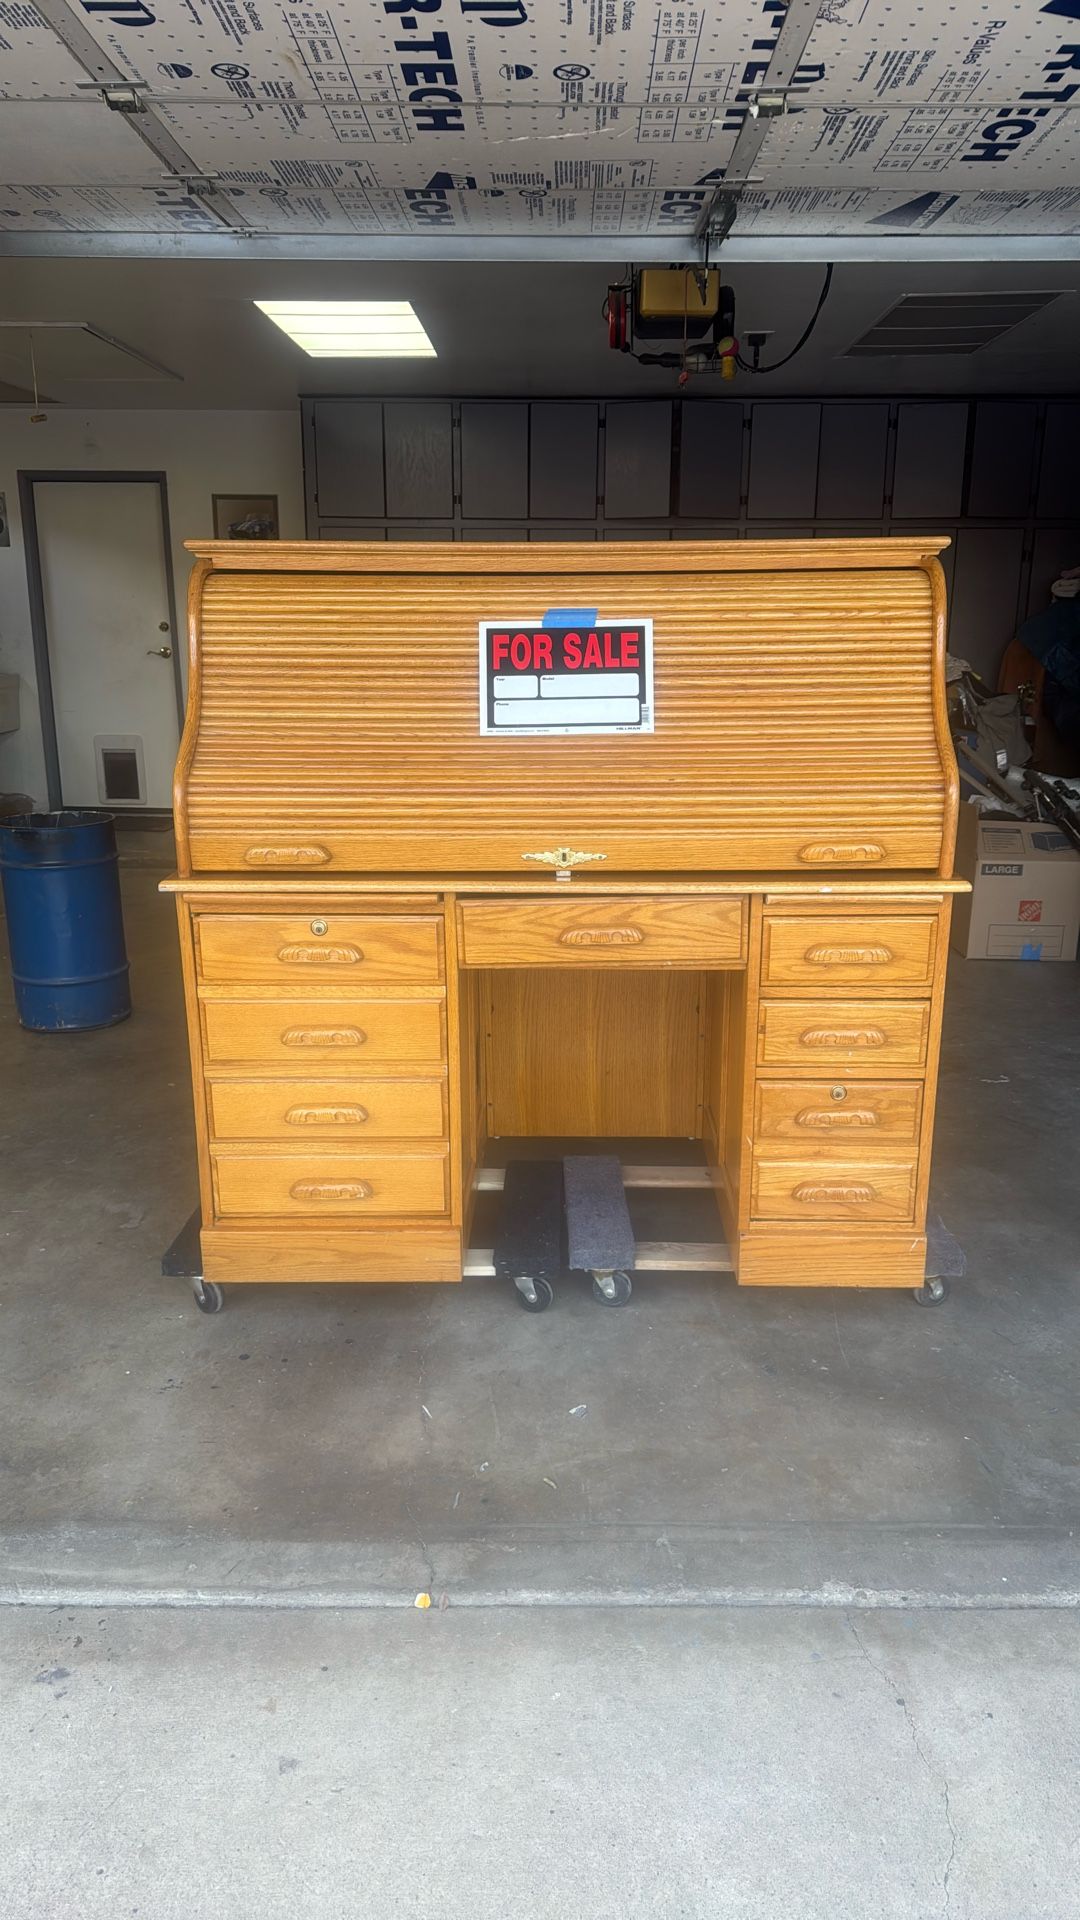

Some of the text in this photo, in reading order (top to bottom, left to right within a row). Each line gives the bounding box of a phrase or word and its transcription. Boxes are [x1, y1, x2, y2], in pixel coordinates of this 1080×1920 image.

[226, 4, 251, 35] and Back
[242, 1, 264, 32] Surfaces
[604, 4, 618, 35] and Back
[622, 1, 636, 32] Surfaces
[962, 20, 1007, 65] R-Values
[384, 0, 465, 131] R-TECH
[888, 50, 920, 89] Front and Back
[906, 50, 936, 86] Skin Surfaces
[493, 632, 639, 670] FOR SALE
[985, 865, 1019, 874] LARGE
